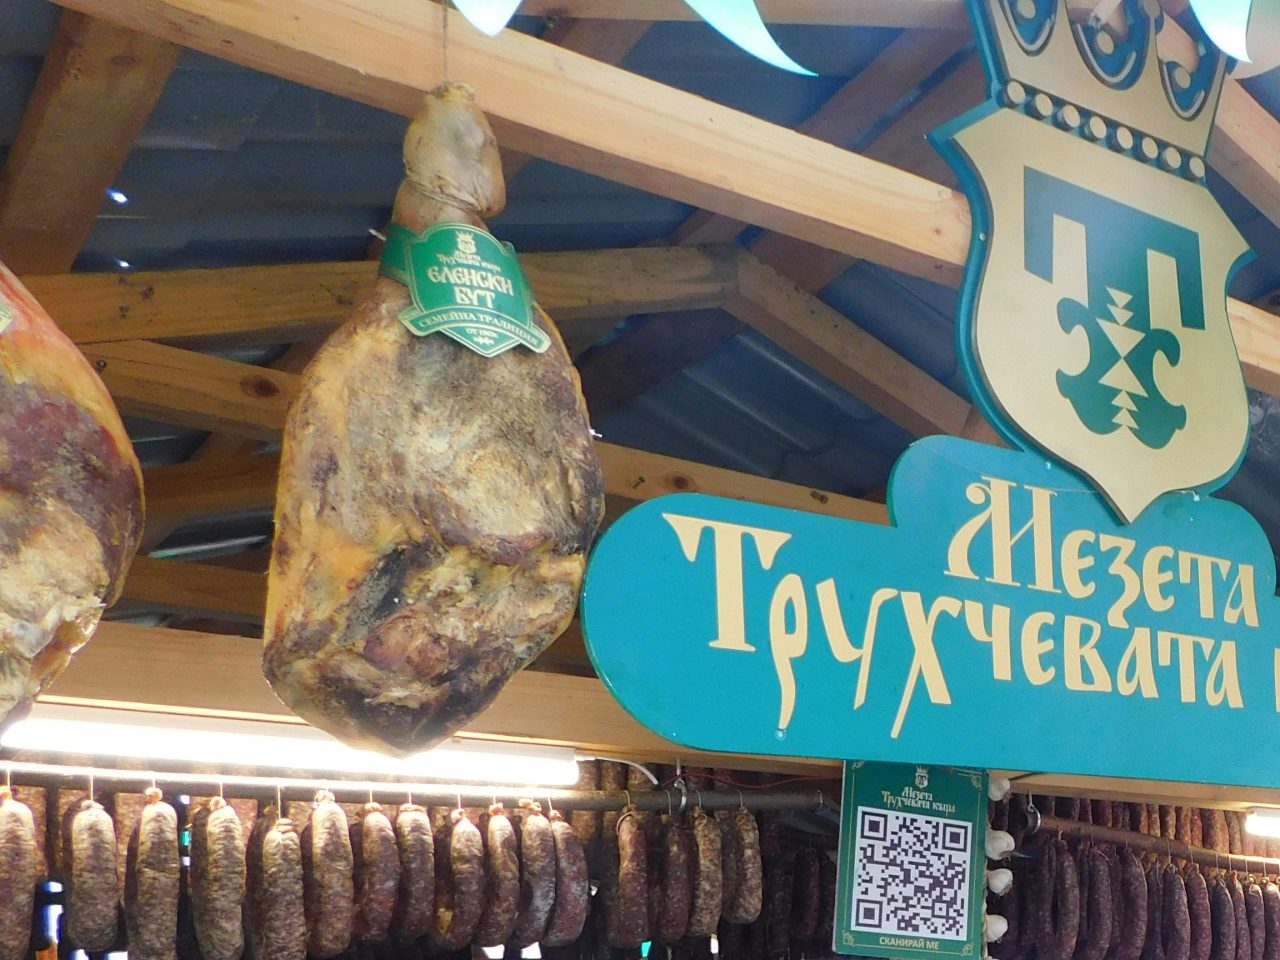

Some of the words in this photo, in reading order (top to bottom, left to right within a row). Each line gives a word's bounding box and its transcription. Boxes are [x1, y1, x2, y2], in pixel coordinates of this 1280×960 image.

[454, 286, 495, 309] БУТ
[662, 512, 1243, 739] Трухчевата
[879, 936, 926, 948] СКАНИРАЙ
[926, 940, 940, 950] МЕ
